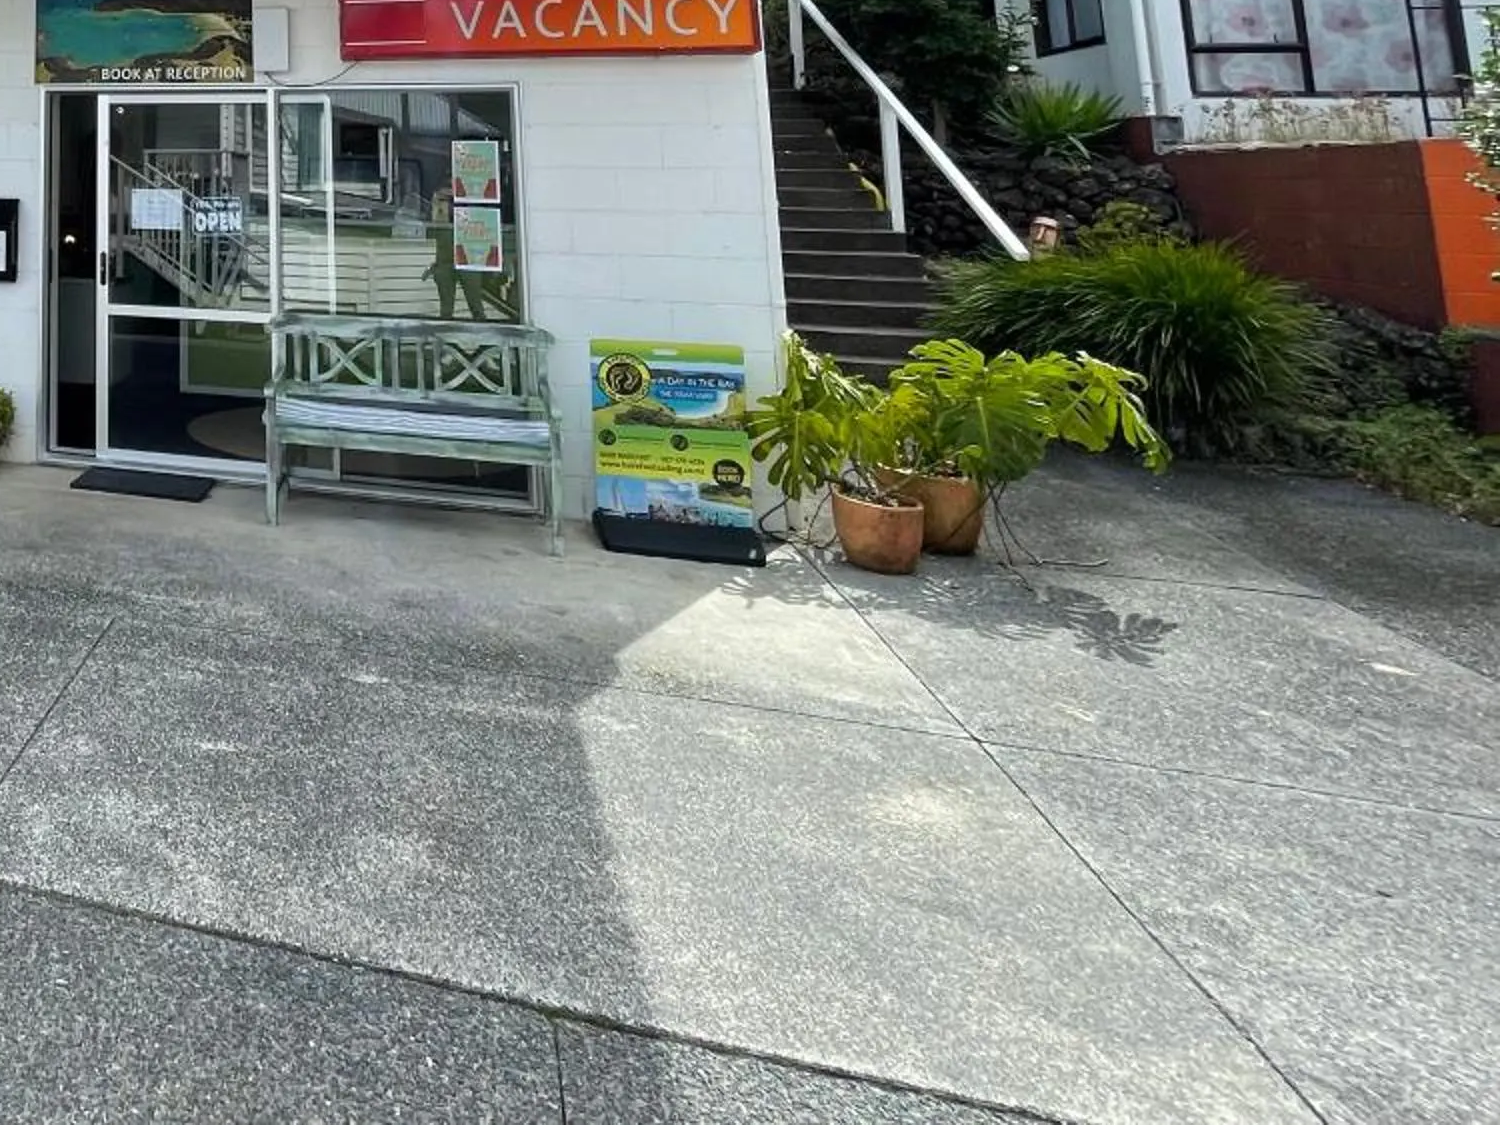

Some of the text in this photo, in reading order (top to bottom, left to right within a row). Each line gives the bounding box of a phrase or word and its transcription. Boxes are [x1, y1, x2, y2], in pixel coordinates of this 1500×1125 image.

[101, 66, 246, 80] BOOK AT RECEPTION
[195, 211, 241, 232] OPEN
